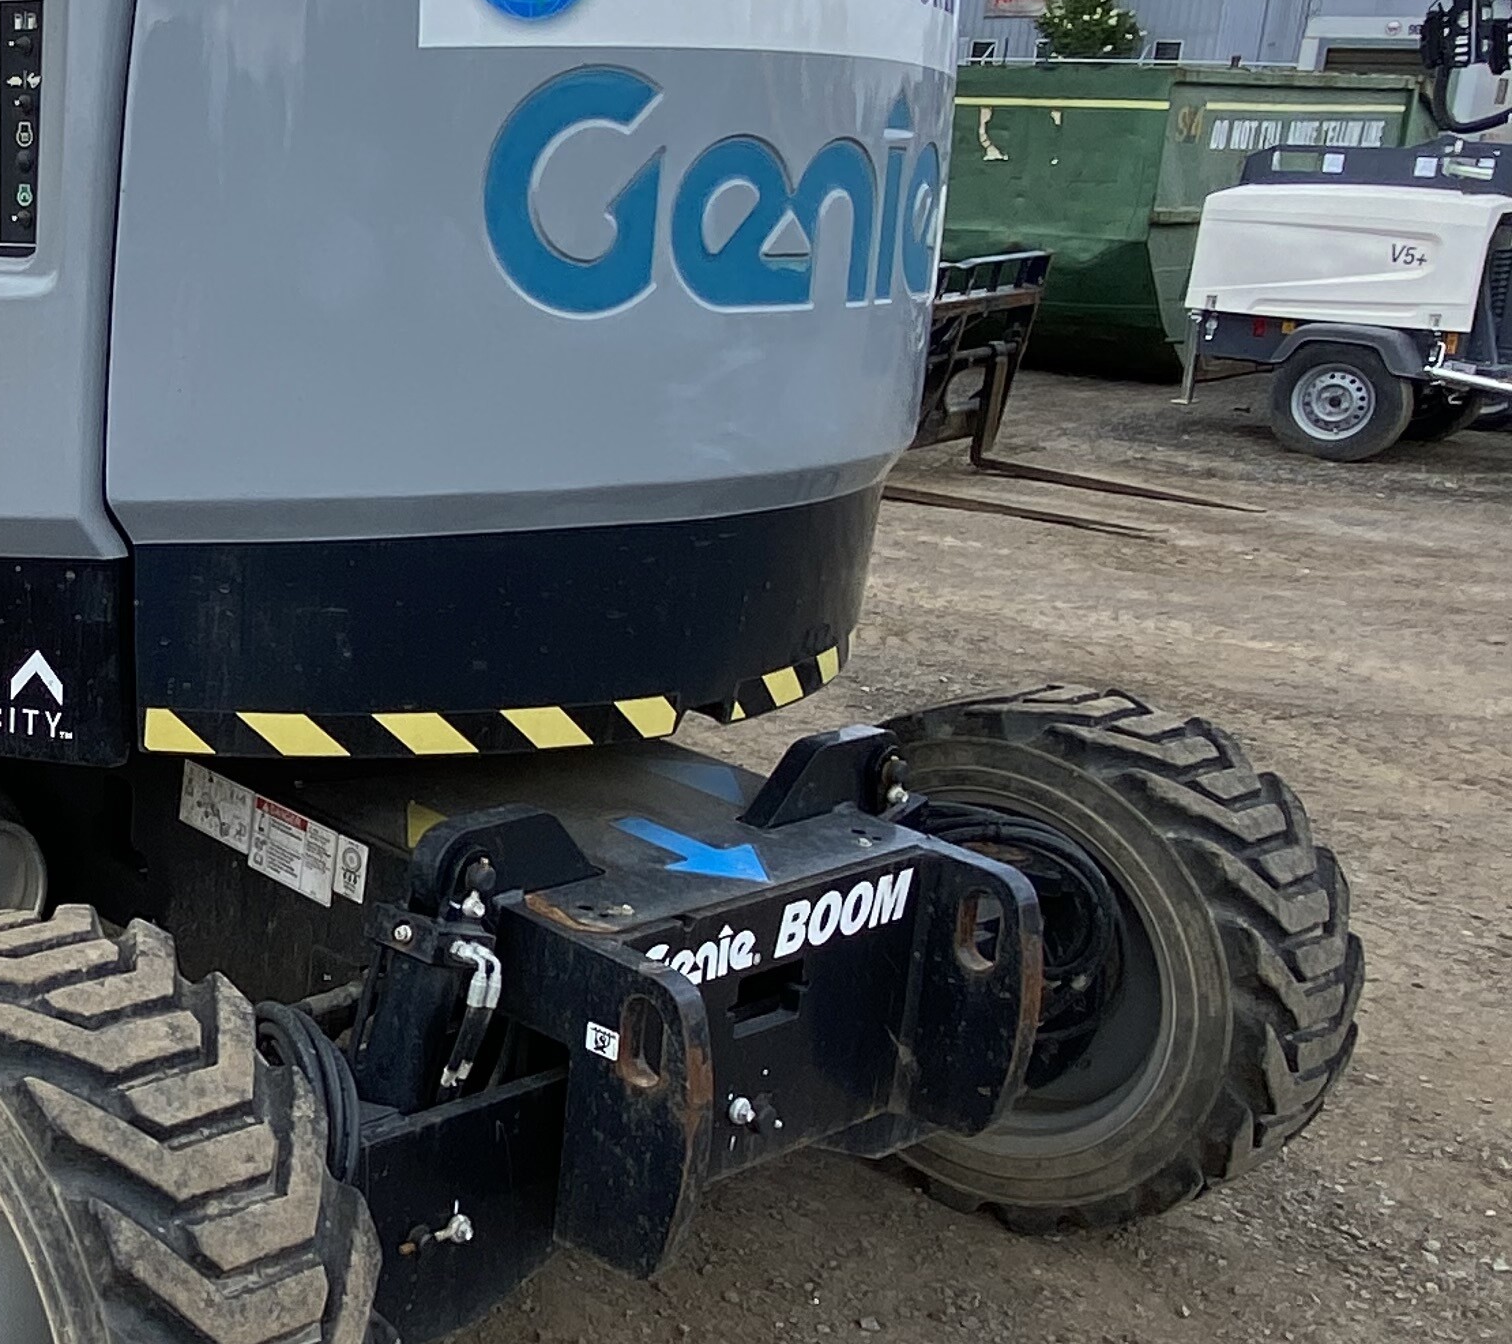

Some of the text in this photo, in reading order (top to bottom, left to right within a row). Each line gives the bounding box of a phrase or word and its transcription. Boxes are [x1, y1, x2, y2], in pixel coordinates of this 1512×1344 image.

[483, 63, 942, 320] Genie
[1391, 243, 1427, 266] V5+
[773, 867, 914, 959] BOOM
